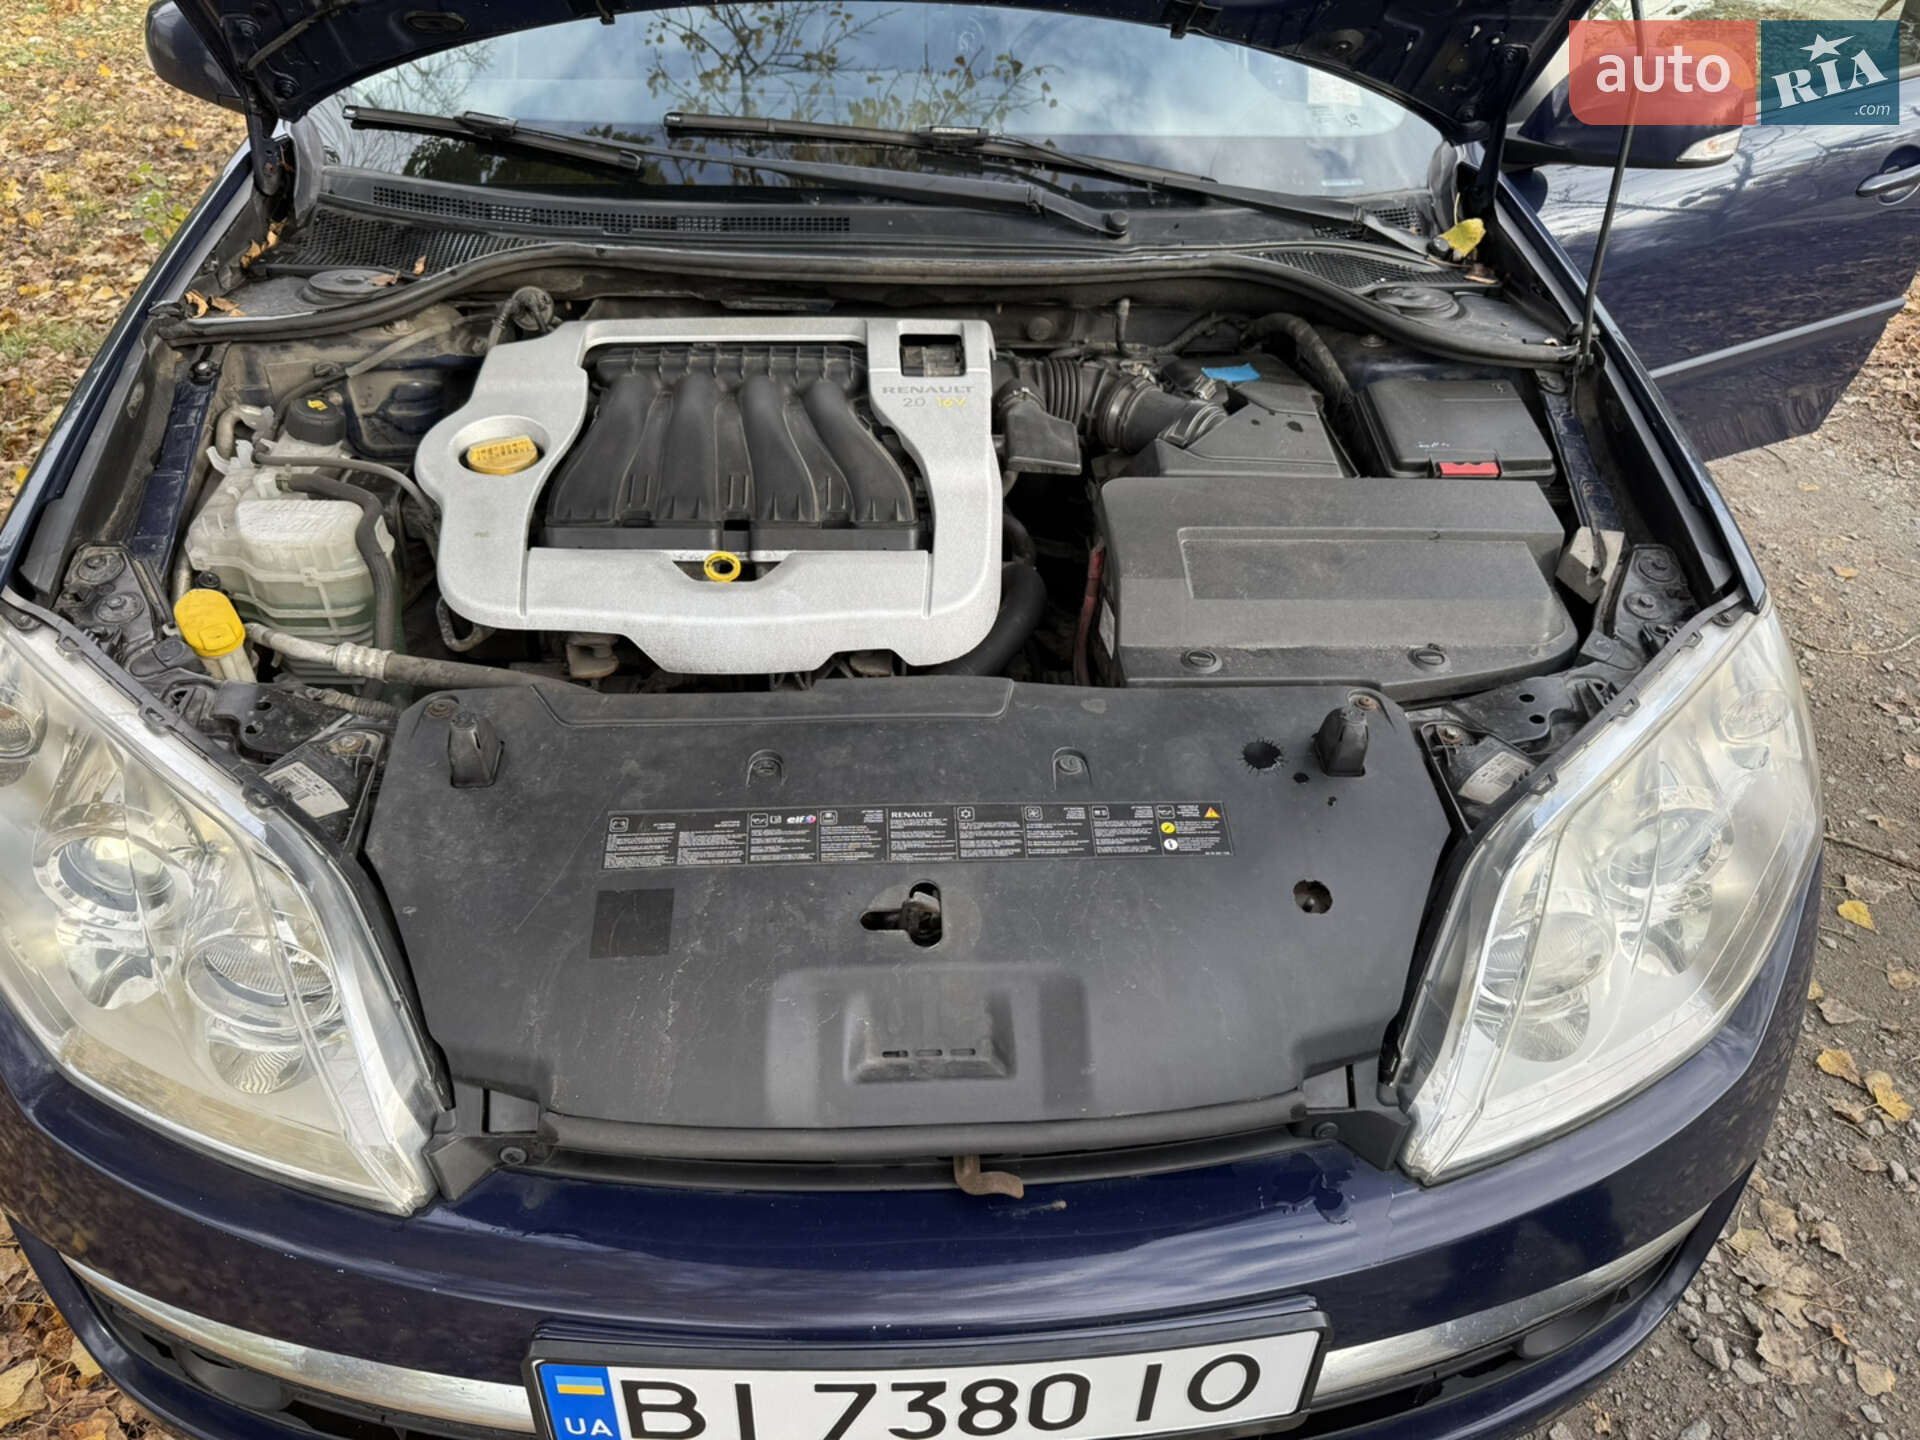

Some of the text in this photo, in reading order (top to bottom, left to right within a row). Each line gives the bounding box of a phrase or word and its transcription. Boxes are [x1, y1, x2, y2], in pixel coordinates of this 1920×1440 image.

[882, 385, 976, 394] RENAULT
[619, 1353, 1261, 1440] BI 7380 IO
[564, 1417, 613, 1438] UA
